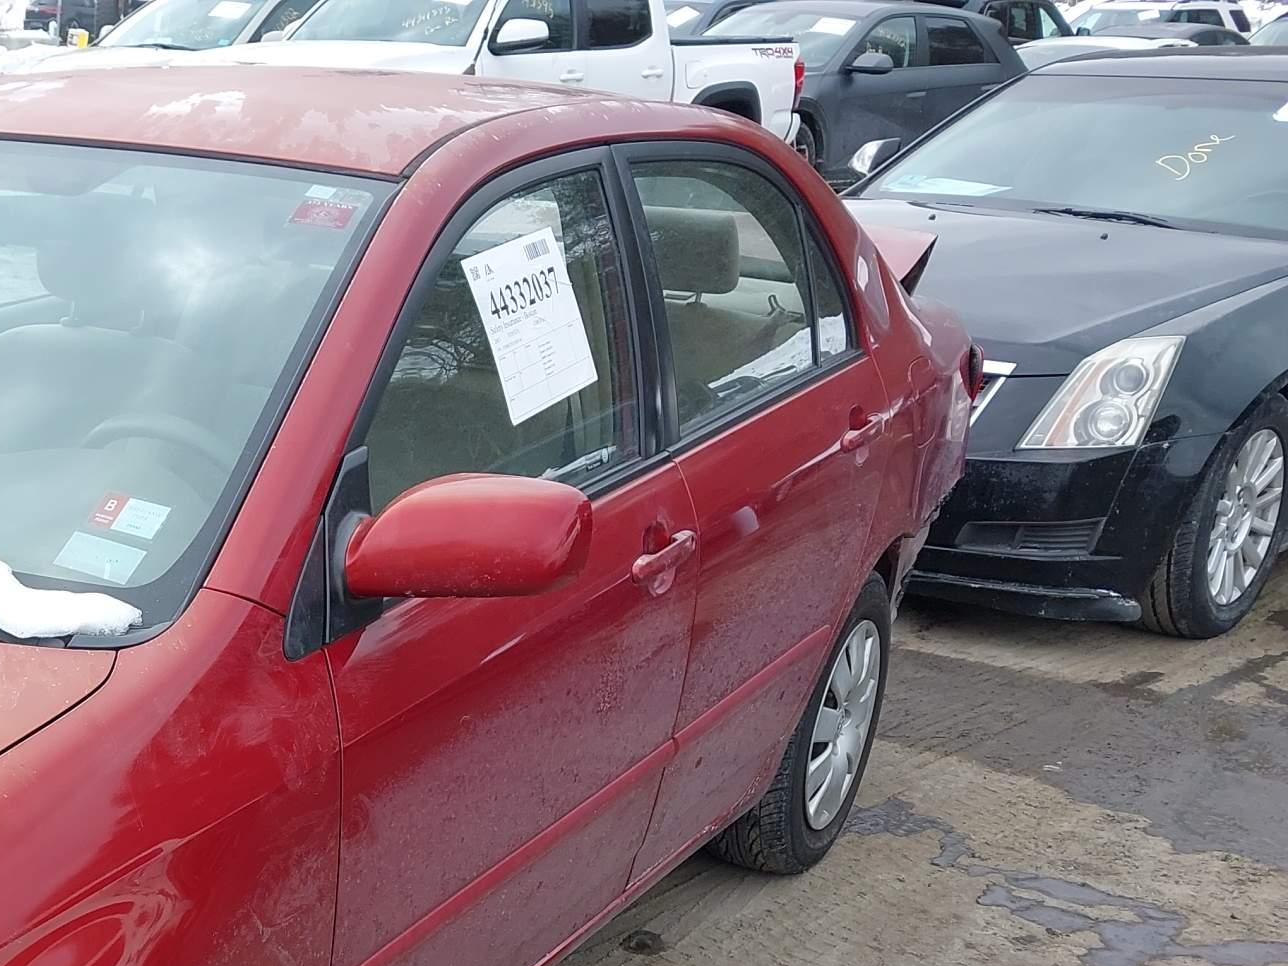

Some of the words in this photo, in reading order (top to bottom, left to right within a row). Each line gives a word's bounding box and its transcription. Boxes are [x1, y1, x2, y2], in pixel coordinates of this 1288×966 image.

[1155, 134, 1236, 181] Done
[490, 266, 559, 319] 44332037
[104, 499, 117, 511] B
